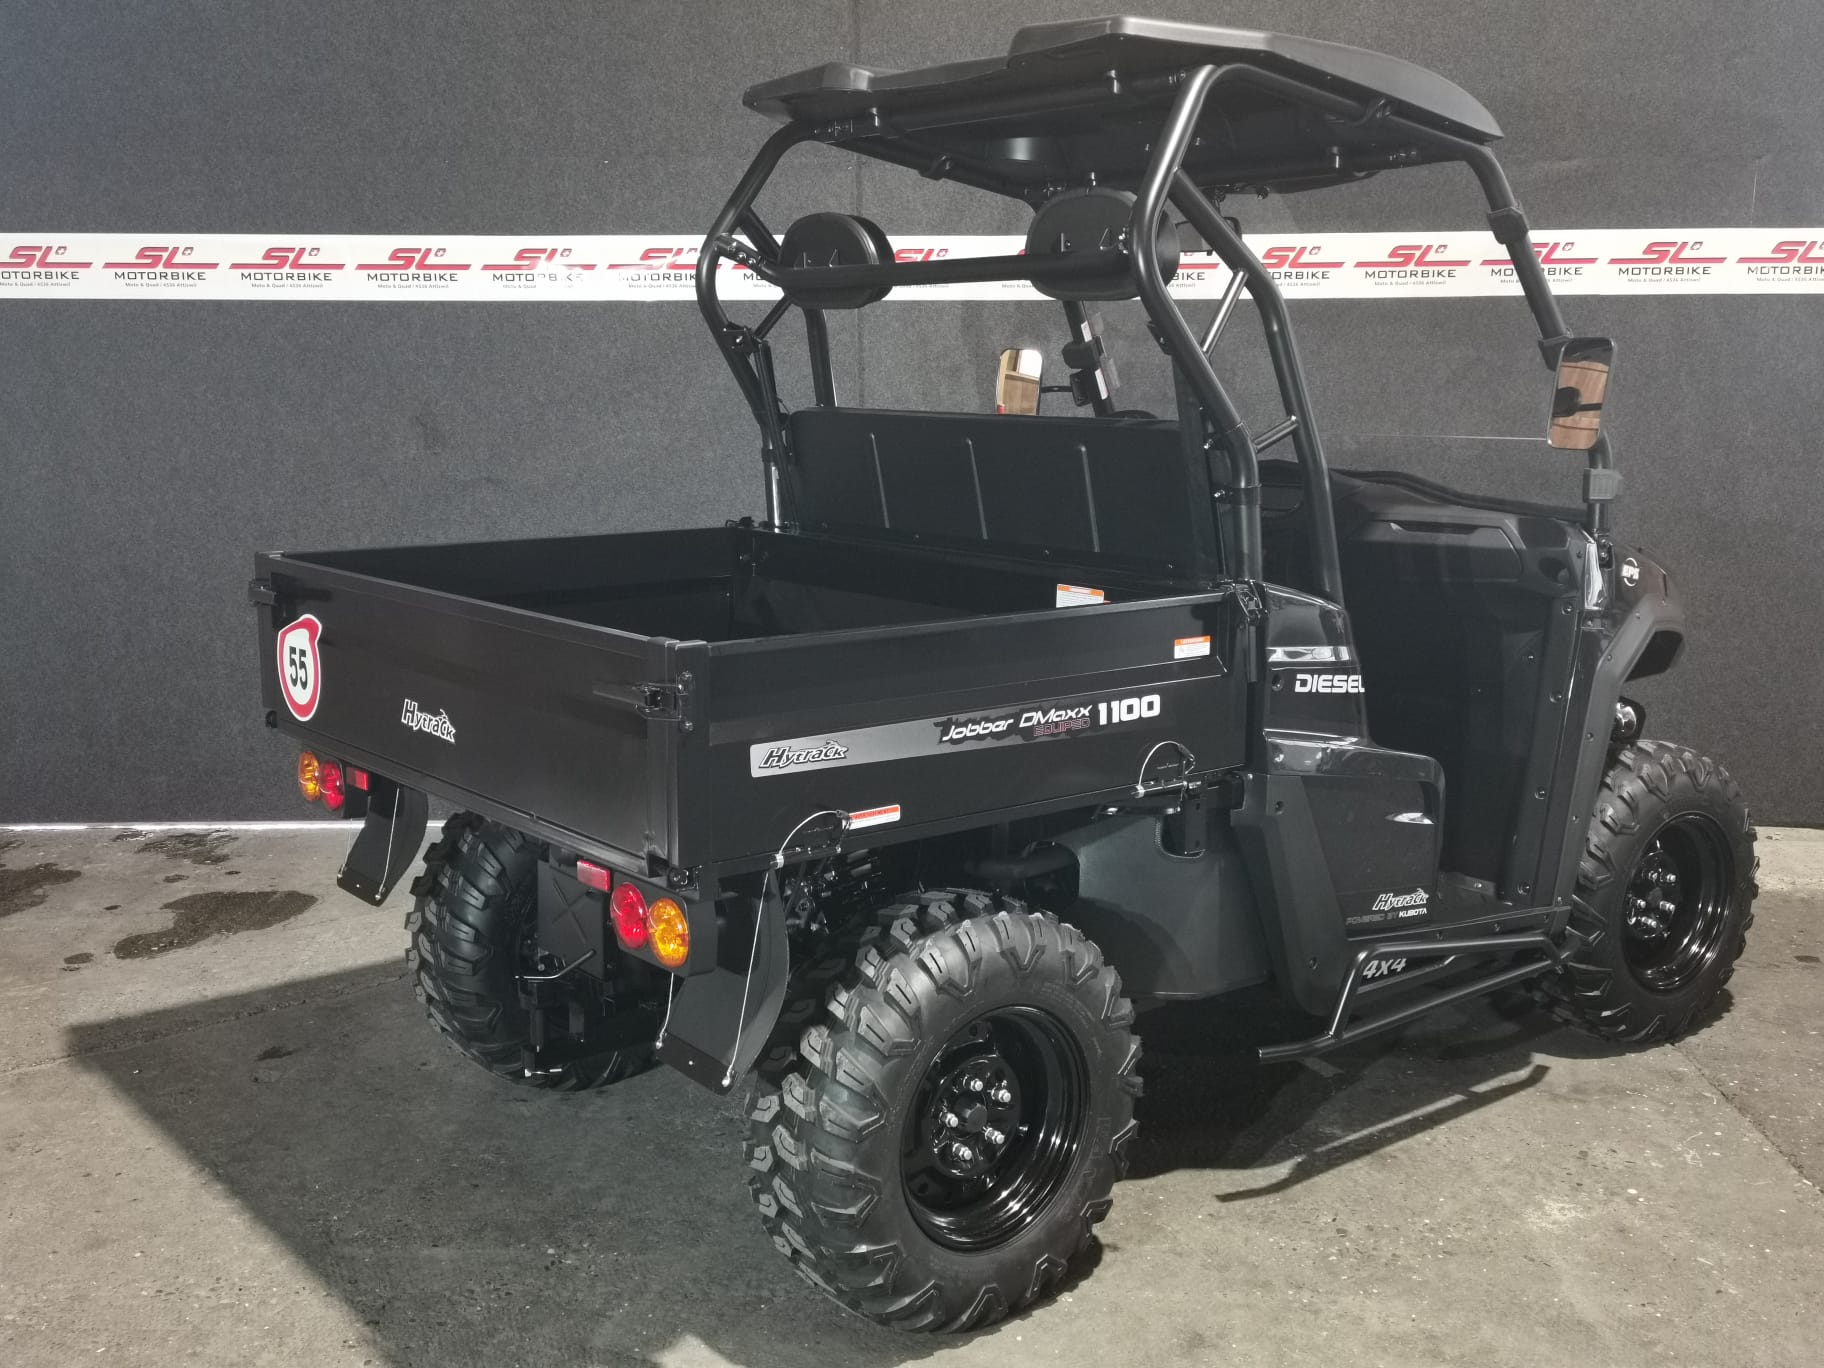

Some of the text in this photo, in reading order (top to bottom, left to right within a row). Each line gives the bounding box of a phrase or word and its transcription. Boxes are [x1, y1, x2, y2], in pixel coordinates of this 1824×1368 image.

[1365, 269, 1457, 279] MOTORBIKE
[1618, 266, 1712, 276] MOTORBIKE
[1747, 265, 1824, 275] MOTORBI
[1, 271, 80, 280] OTORBIKE
[114, 271, 207, 281] MOTORBIKE
[241, 272, 333, 281] MOTORBIKE
[367, 273, 458, 282] MOTORBIKE
[288, 645, 308, 691] 55
[1294, 673, 1366, 693] DIESEL
[401, 698, 457, 743] Hytrack
[942, 694, 1161, 742] Jobber DMaxx 1100
[759, 745, 848, 769] Hytrack
[1371, 892, 1429, 911] Hytrack
[1399, 907, 1428, 918] KUBOTA
